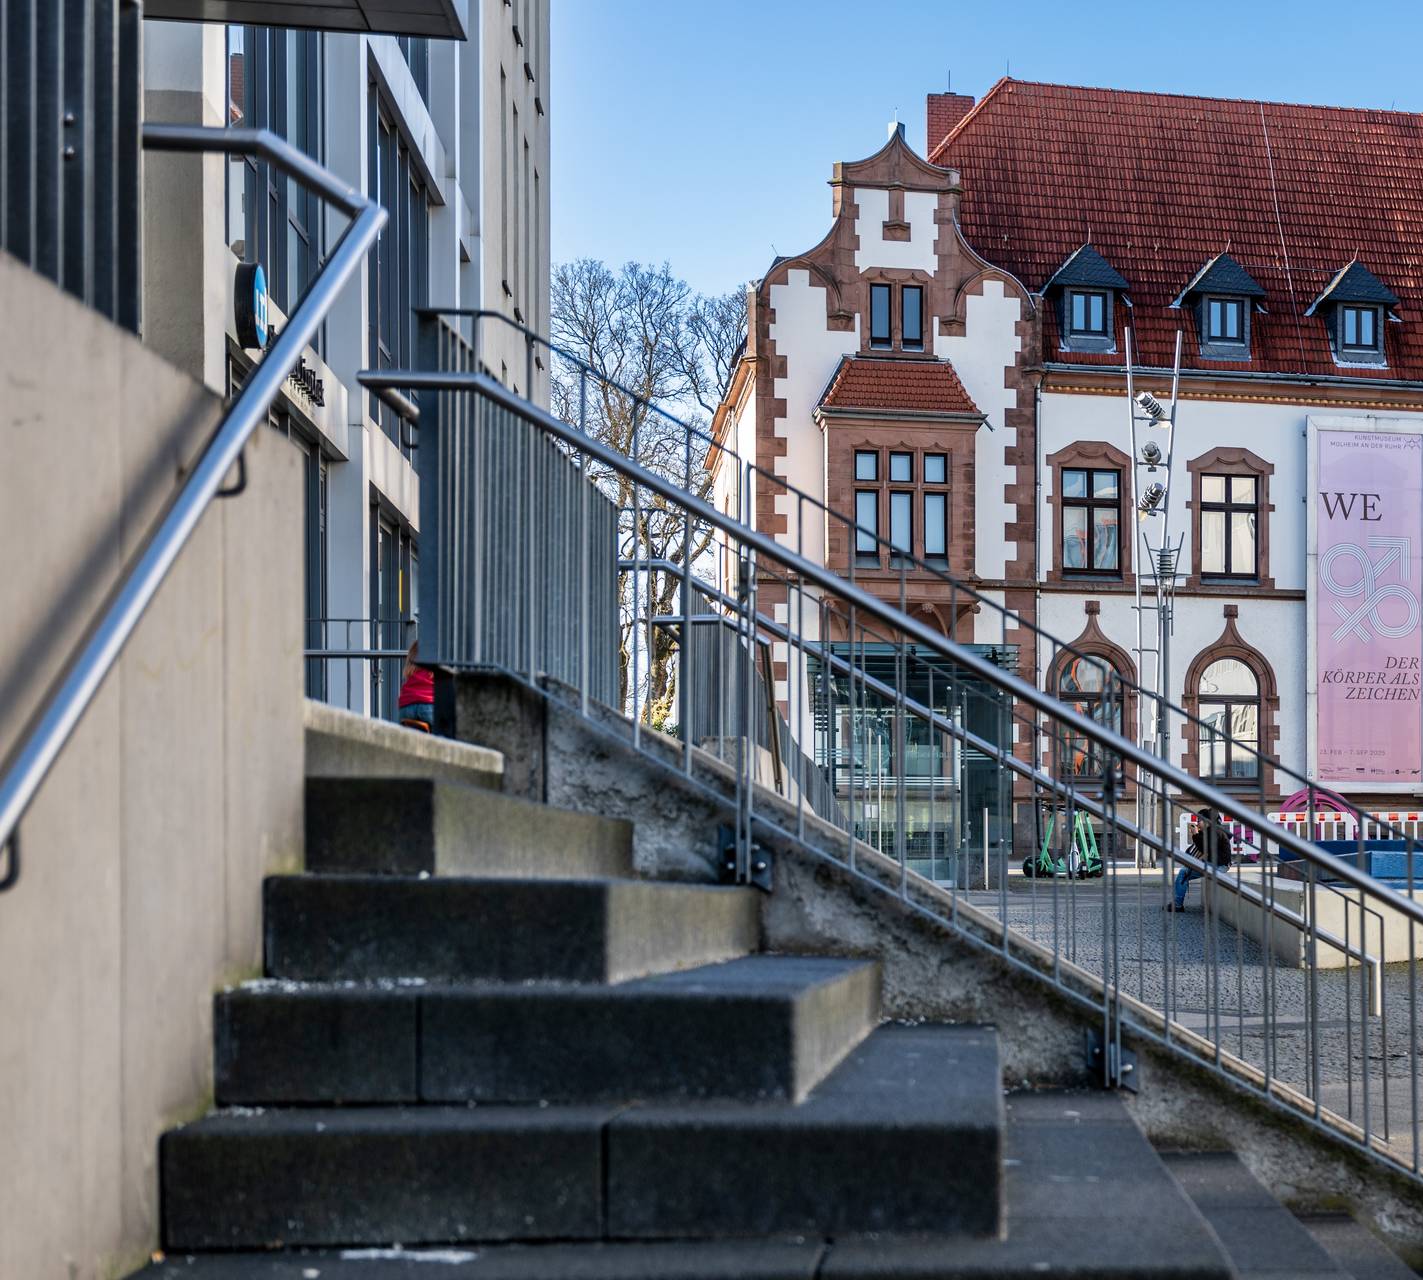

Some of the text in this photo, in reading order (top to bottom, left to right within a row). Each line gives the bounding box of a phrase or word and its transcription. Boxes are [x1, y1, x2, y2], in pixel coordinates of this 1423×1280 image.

[1354, 434, 1402, 442] KUNSTMUSEUM
[1319, 491, 1383, 521] WE
[1384, 656, 1420, 670] DER
[1321, 668, 1421, 686] KÖRPER ALS
[1344, 686, 1421, 701] ZEICHEN
